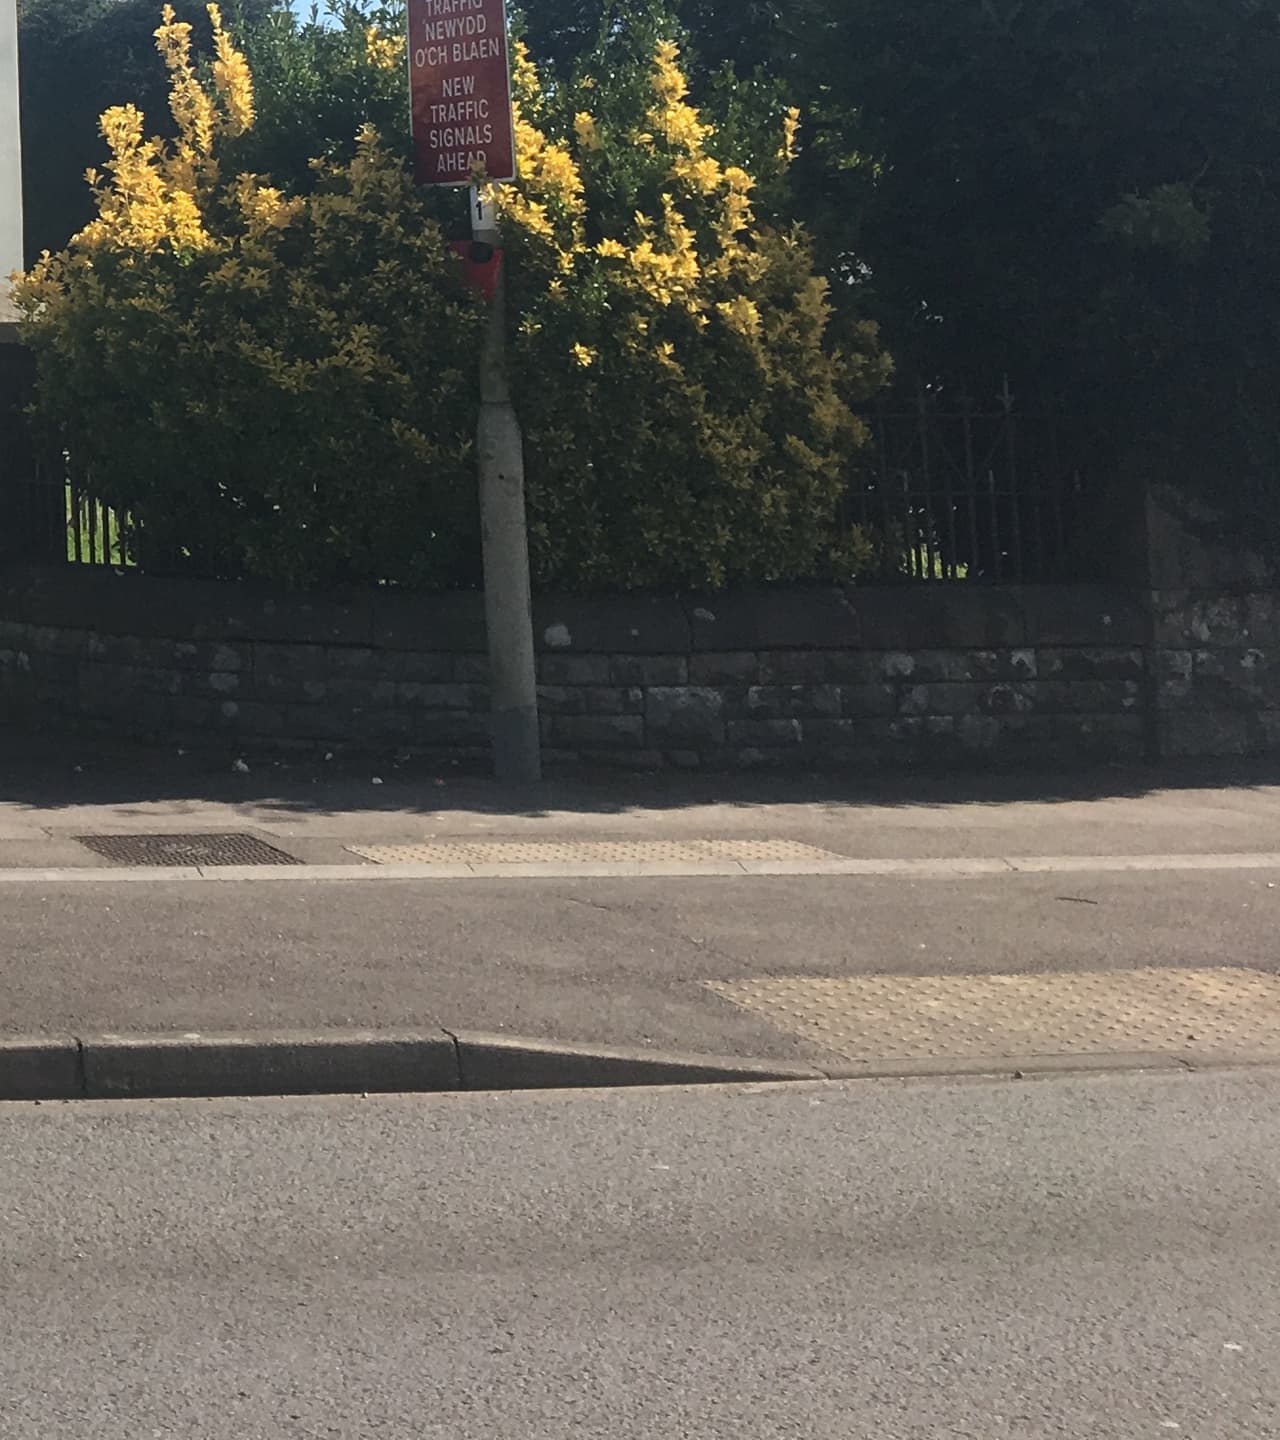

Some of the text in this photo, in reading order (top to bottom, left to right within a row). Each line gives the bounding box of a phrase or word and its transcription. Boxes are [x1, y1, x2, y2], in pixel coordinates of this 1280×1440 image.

[425, 15, 486, 41] NEWYDD
[415, 37, 500, 68] O'CH BLAEN
[442, 75, 475, 97] NEW
[430, 99, 489, 124] TRAFFIC
[429, 124, 493, 149] SIGNALS
